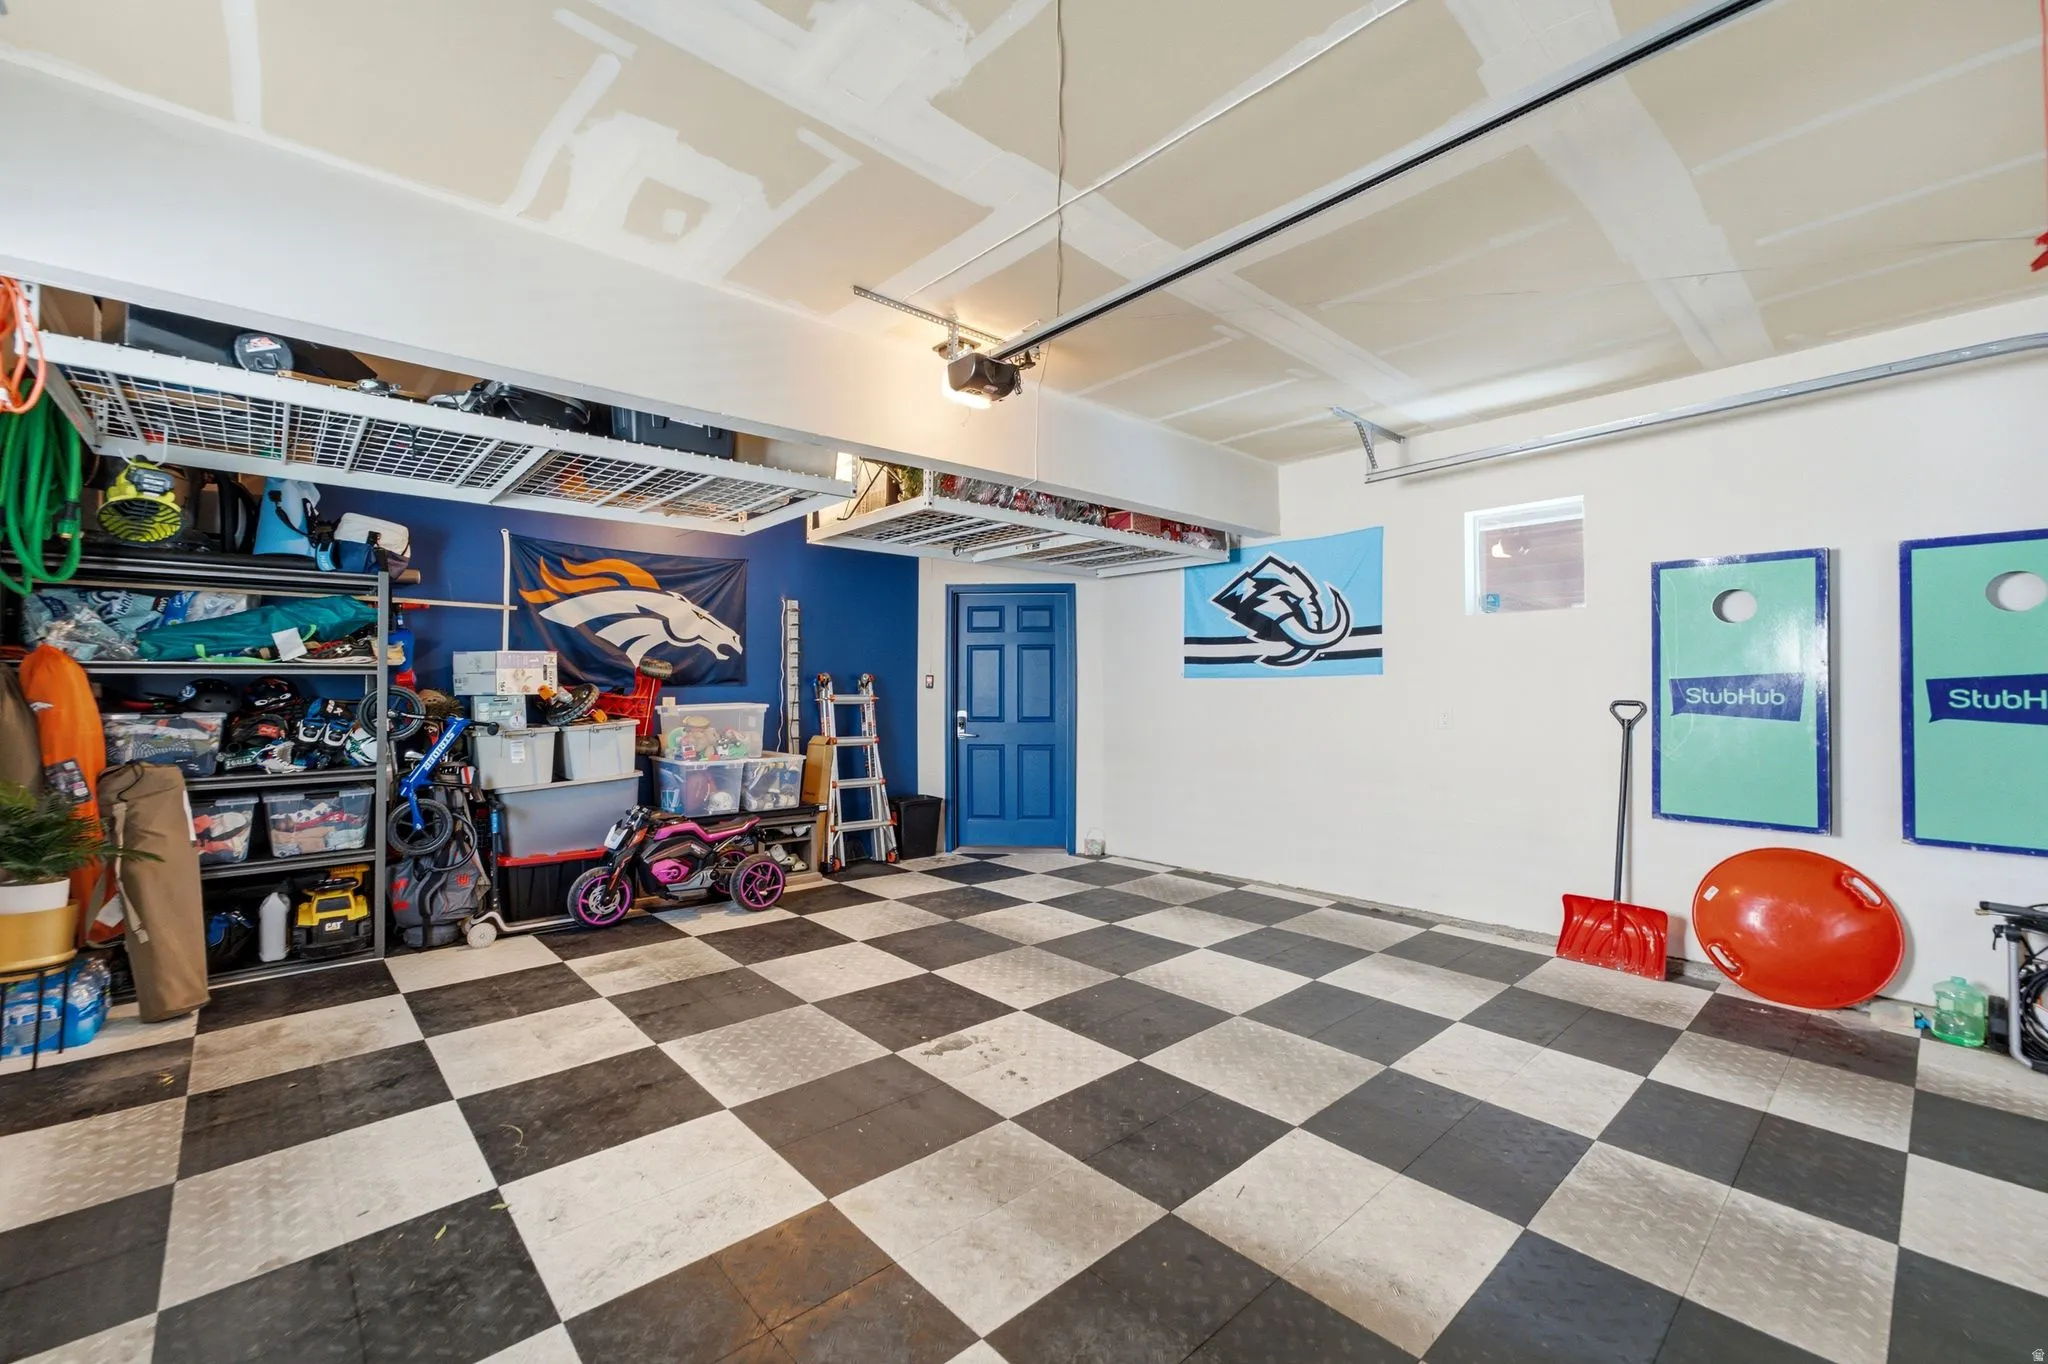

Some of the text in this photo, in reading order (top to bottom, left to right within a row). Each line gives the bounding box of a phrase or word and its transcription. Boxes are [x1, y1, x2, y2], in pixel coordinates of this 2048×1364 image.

[1685, 687, 1786, 705] StubHub
[1948, 688, 2048, 710] StubH
[424, 732, 455, 771] STRIDER
[325, 921, 343, 932] CAT
